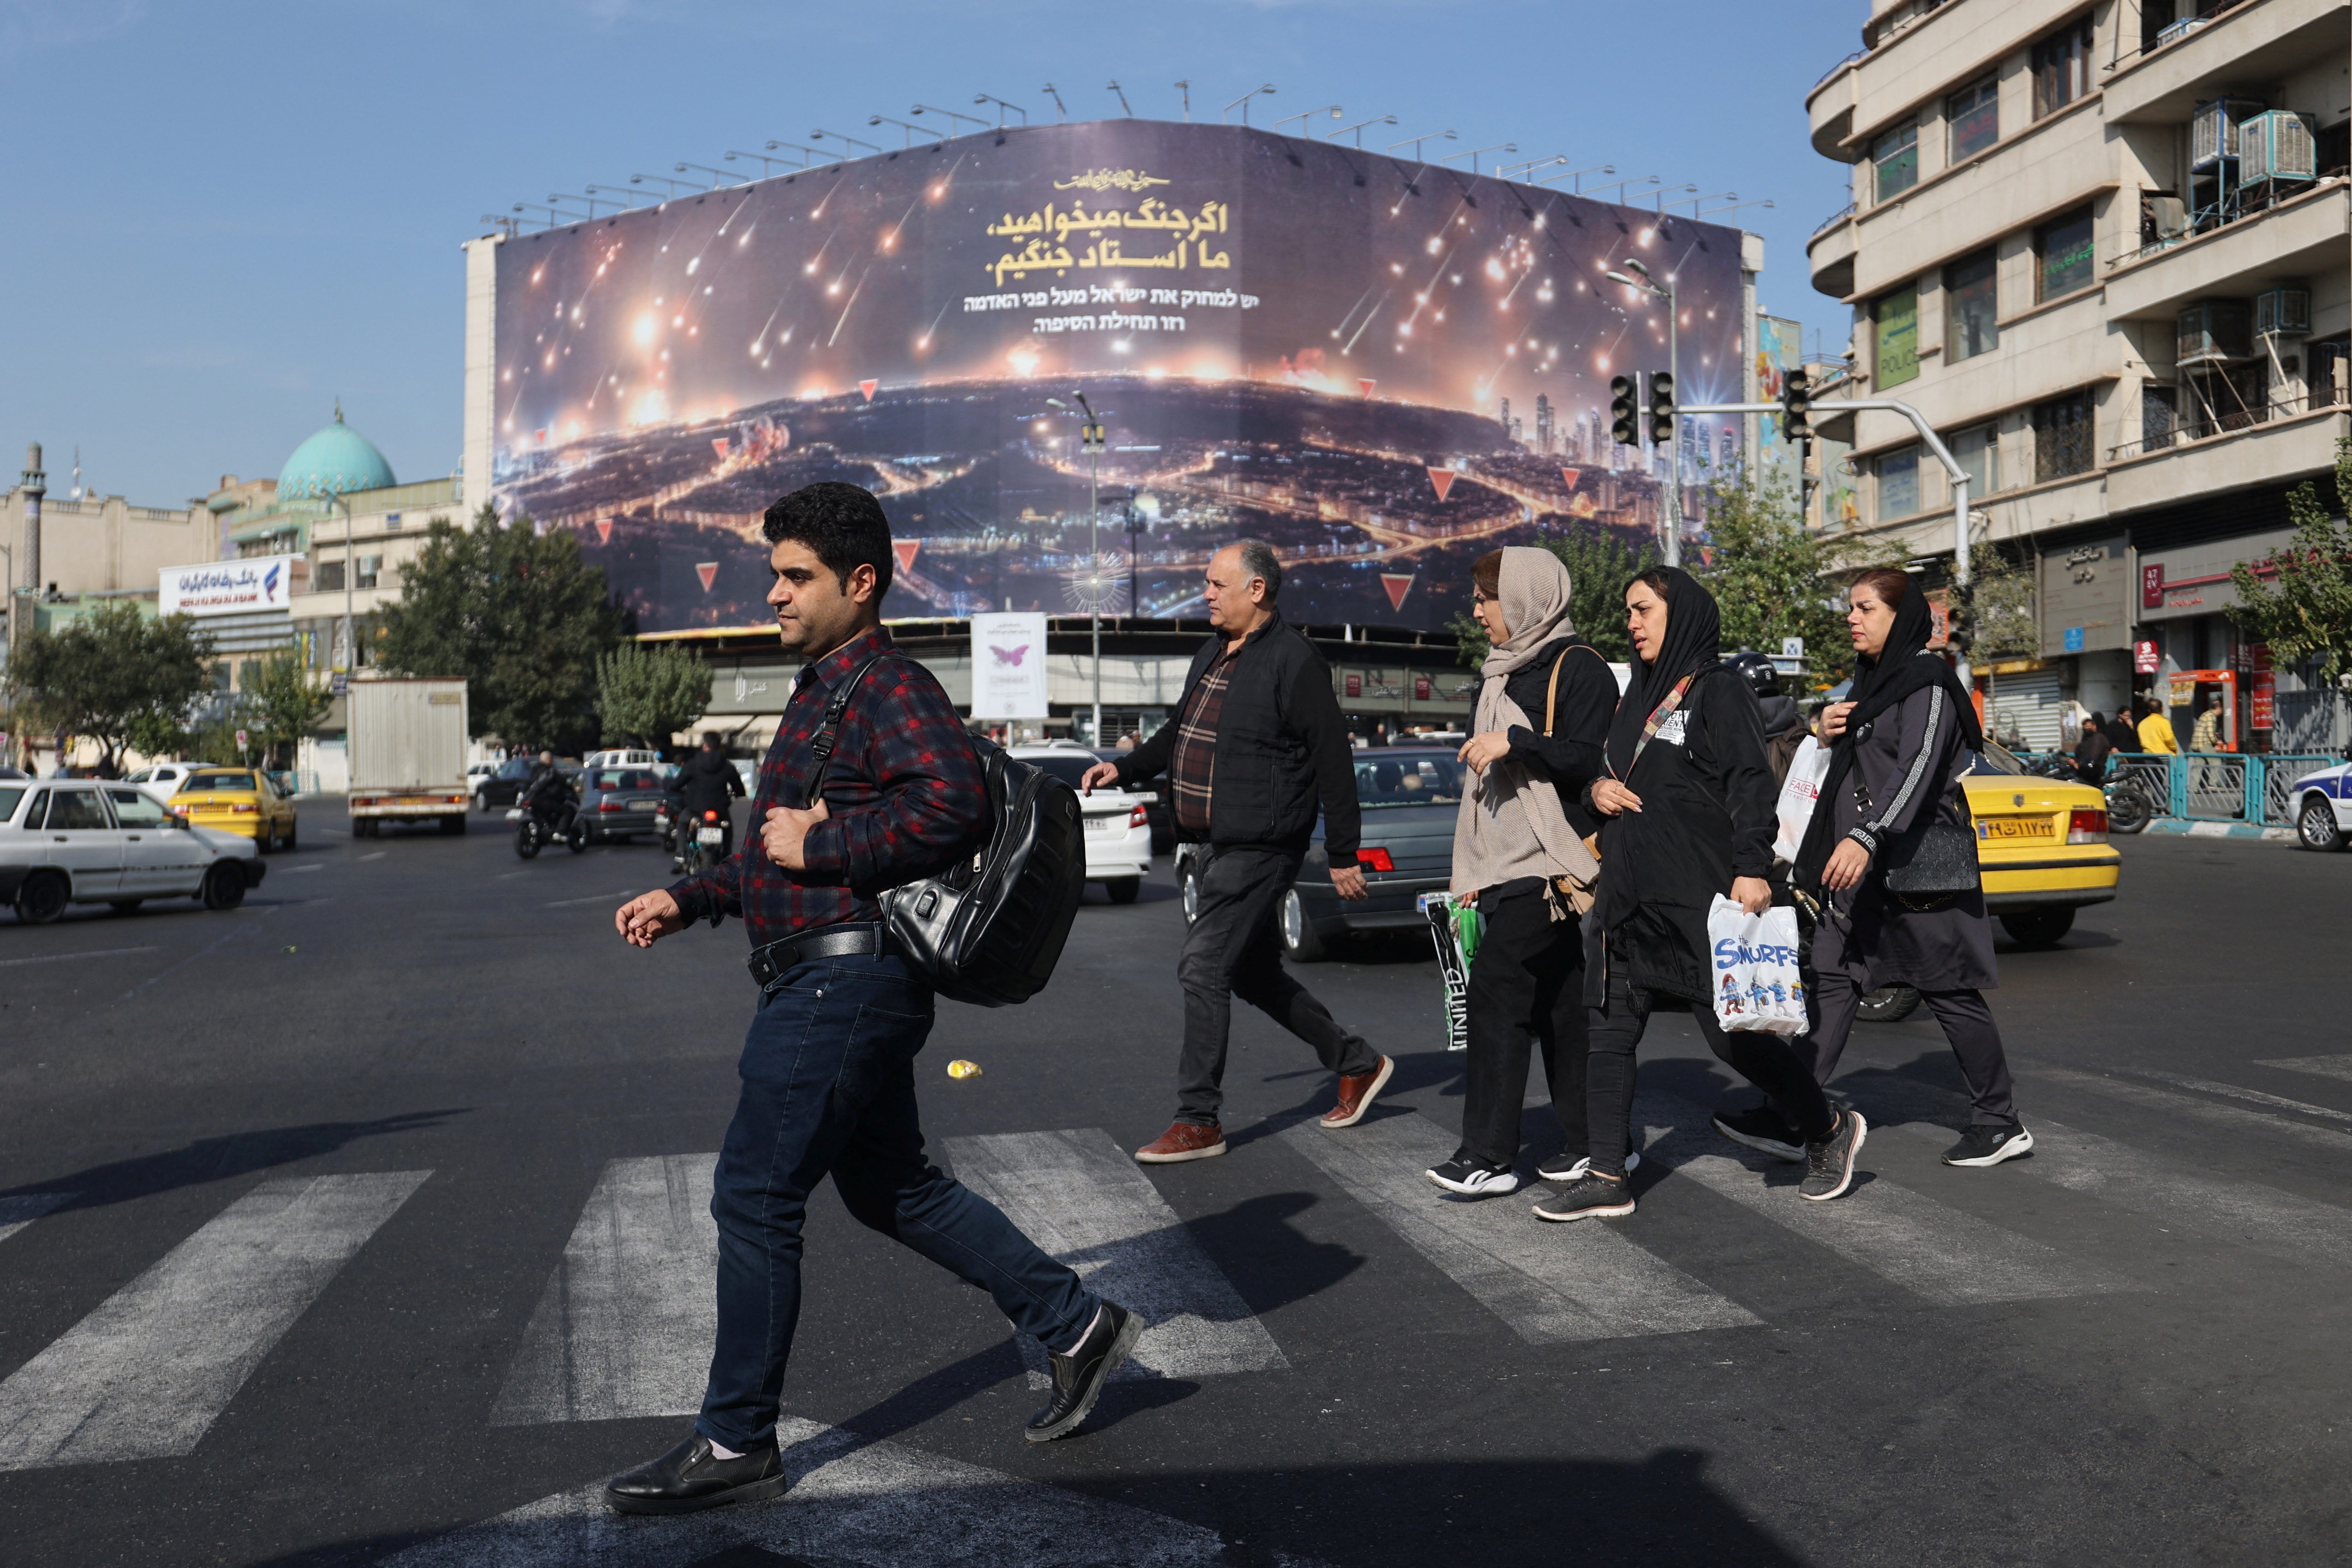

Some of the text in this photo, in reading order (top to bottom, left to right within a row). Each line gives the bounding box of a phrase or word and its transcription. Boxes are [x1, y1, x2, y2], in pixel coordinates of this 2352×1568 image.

[1122, 196, 1191, 240] جنگ
[1187, 200, 1228, 243] اگر
[1078, 237, 1188, 271] استاد
[1198, 238, 1231, 270] ما
[1021, 291, 1049, 308] פני
[1049, 286, 1088, 306] מעל
[1089, 284, 1148, 304] ישראל
[1149, 288, 1179, 304] את
[1240, 293, 1260, 309] יש
[1098, 310, 1158, 331] תחילת
[1785, 791, 1816, 805] DERMOCOS
[1738, 934, 1749, 946] the
[1714, 938, 1799, 969] SMURFS
